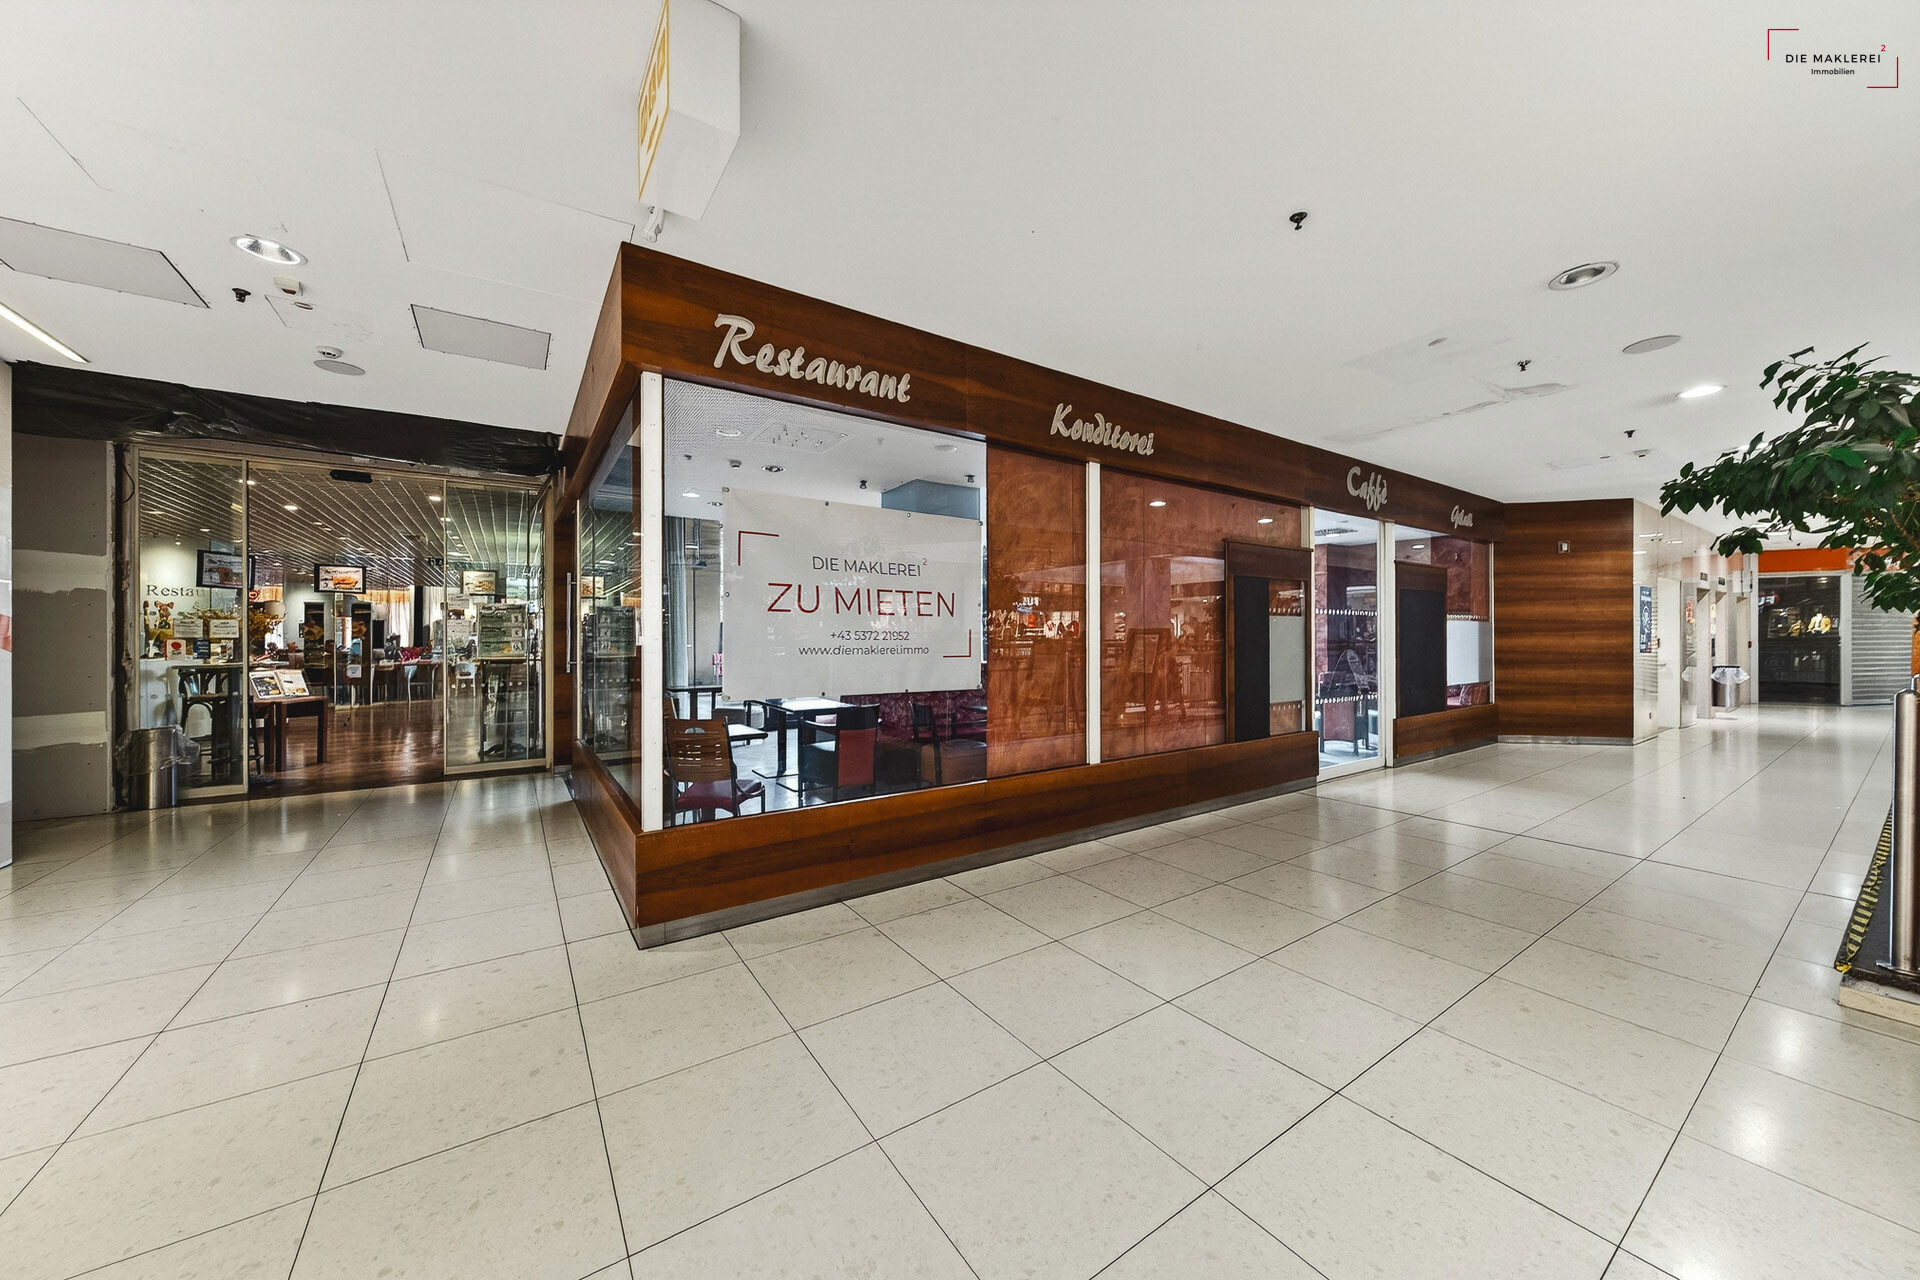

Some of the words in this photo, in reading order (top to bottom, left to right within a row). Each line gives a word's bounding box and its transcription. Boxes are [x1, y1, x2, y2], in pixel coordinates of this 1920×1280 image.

[713, 313, 911, 403] Restaurant
[1050, 403, 1155, 456] Konditorei
[812, 556, 840, 572] DIE
[844, 558, 921, 577] MAKLEREI
[767, 582, 821, 614] ZU
[835, 587, 956, 618] MIETEN
[830, 631, 851, 642] +43
[854, 631, 879, 641] 5372
[881, 631, 910, 641] 21952
[798, 645, 930, 657] www.diemaklerei.immo
